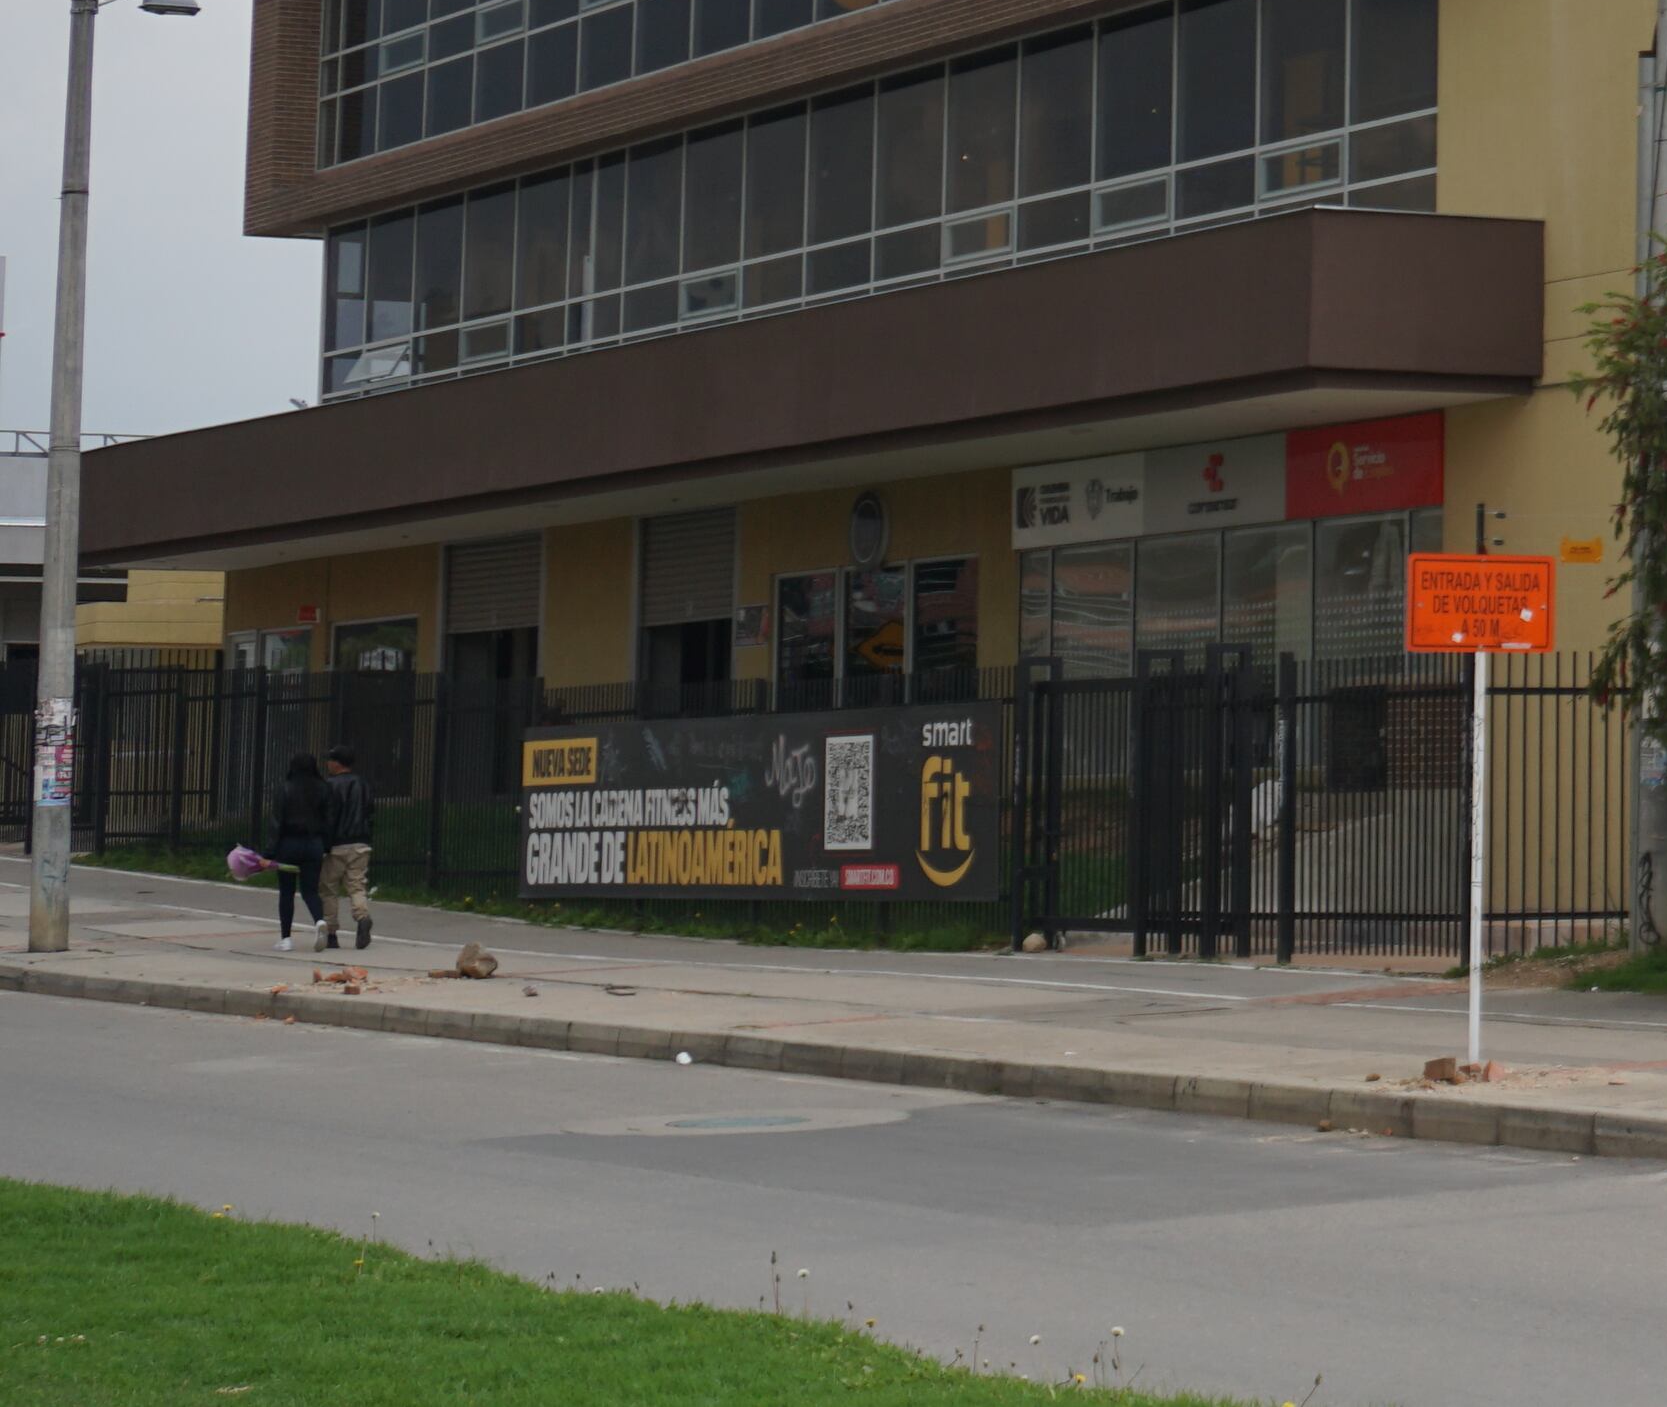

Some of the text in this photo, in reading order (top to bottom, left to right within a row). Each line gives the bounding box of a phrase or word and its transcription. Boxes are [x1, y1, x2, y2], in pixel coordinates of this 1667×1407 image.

[1039, 505, 1070, 526] VIDA
[1421, 571, 1541, 592] ENTRADA Y SALIDA
[1433, 595, 1528, 615] DE VOLQUETAS
[1461, 618, 1500, 637] A 50 M
[922, 718, 973, 747] smart
[533, 746, 592, 778] NUEVA SEDE
[529, 779, 729, 829] SOMOS LA CADENA FITNESS MÁS
[921, 756, 970, 852] fit
[526, 818, 783, 886] GRANDE DE LATINOAMÉRICA
